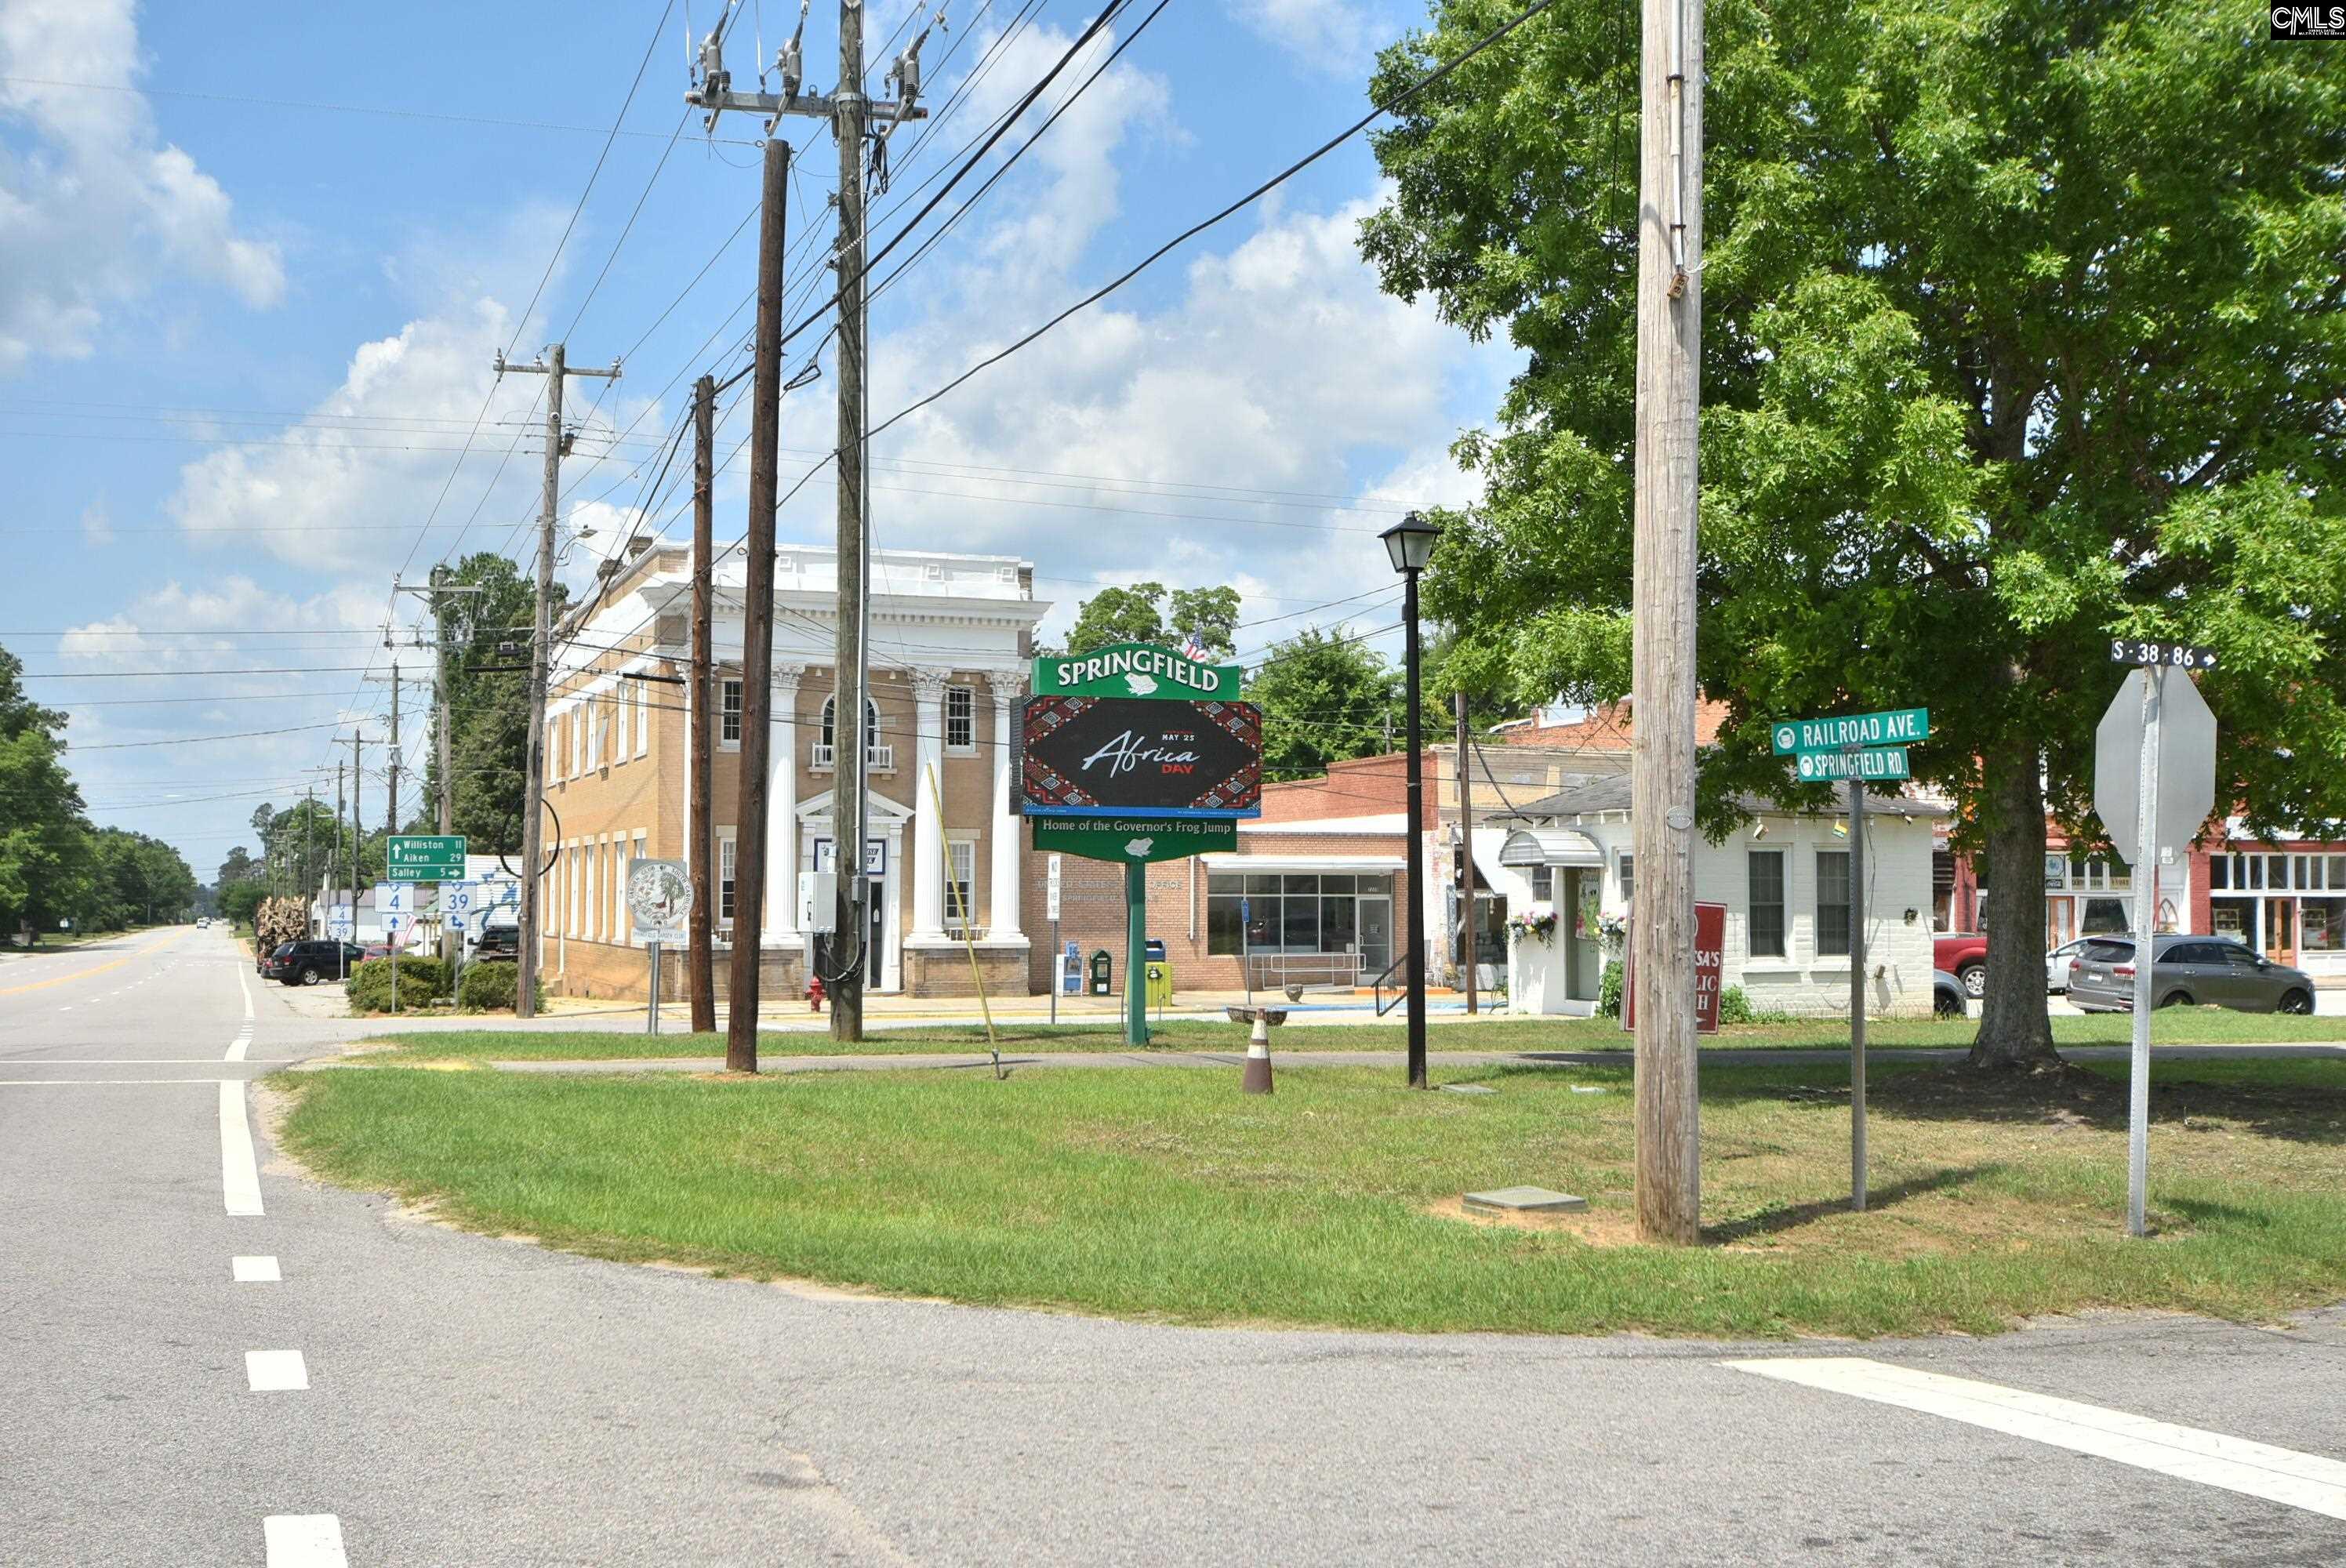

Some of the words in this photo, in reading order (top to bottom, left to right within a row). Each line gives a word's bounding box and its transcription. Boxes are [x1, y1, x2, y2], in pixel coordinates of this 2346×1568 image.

[2113, 641, 2123, 659] S
[2137, 642, 2159, 662] 38
[2173, 645, 2195, 666] 86
[1058, 650, 1219, 692] SPRINGFIELD
[1803, 718, 1880, 747] RAILROAD
[1887, 714, 1920, 739] AVE.
[1081, 730, 1201, 779] Africa
[1161, 764, 1194, 774] DAY
[1814, 752, 1884, 777] SPRINGFIELD
[1888, 752, 1906, 775] RD.
[1043, 819, 1075, 831] Home
[1078, 820, 1091, 831] of
[1093, 820, 1110, 831] the
[1113, 822, 1172, 833] Governor's
[1176, 823, 1200, 835] Frog
[1203, 823, 1231, 835] Jump
[403, 840, 445, 849] Williston
[455, 840, 462, 849] 11
[403, 854, 430, 862] Aiken
[449, 854, 462, 862] 29
[392, 868, 421, 878] Salley
[440, 868, 446, 877] 5
[389, 895, 399, 909] 4
[448, 894, 469, 910] 39
[339, 911, 345, 920] 4
[336, 927, 348, 937] 39
